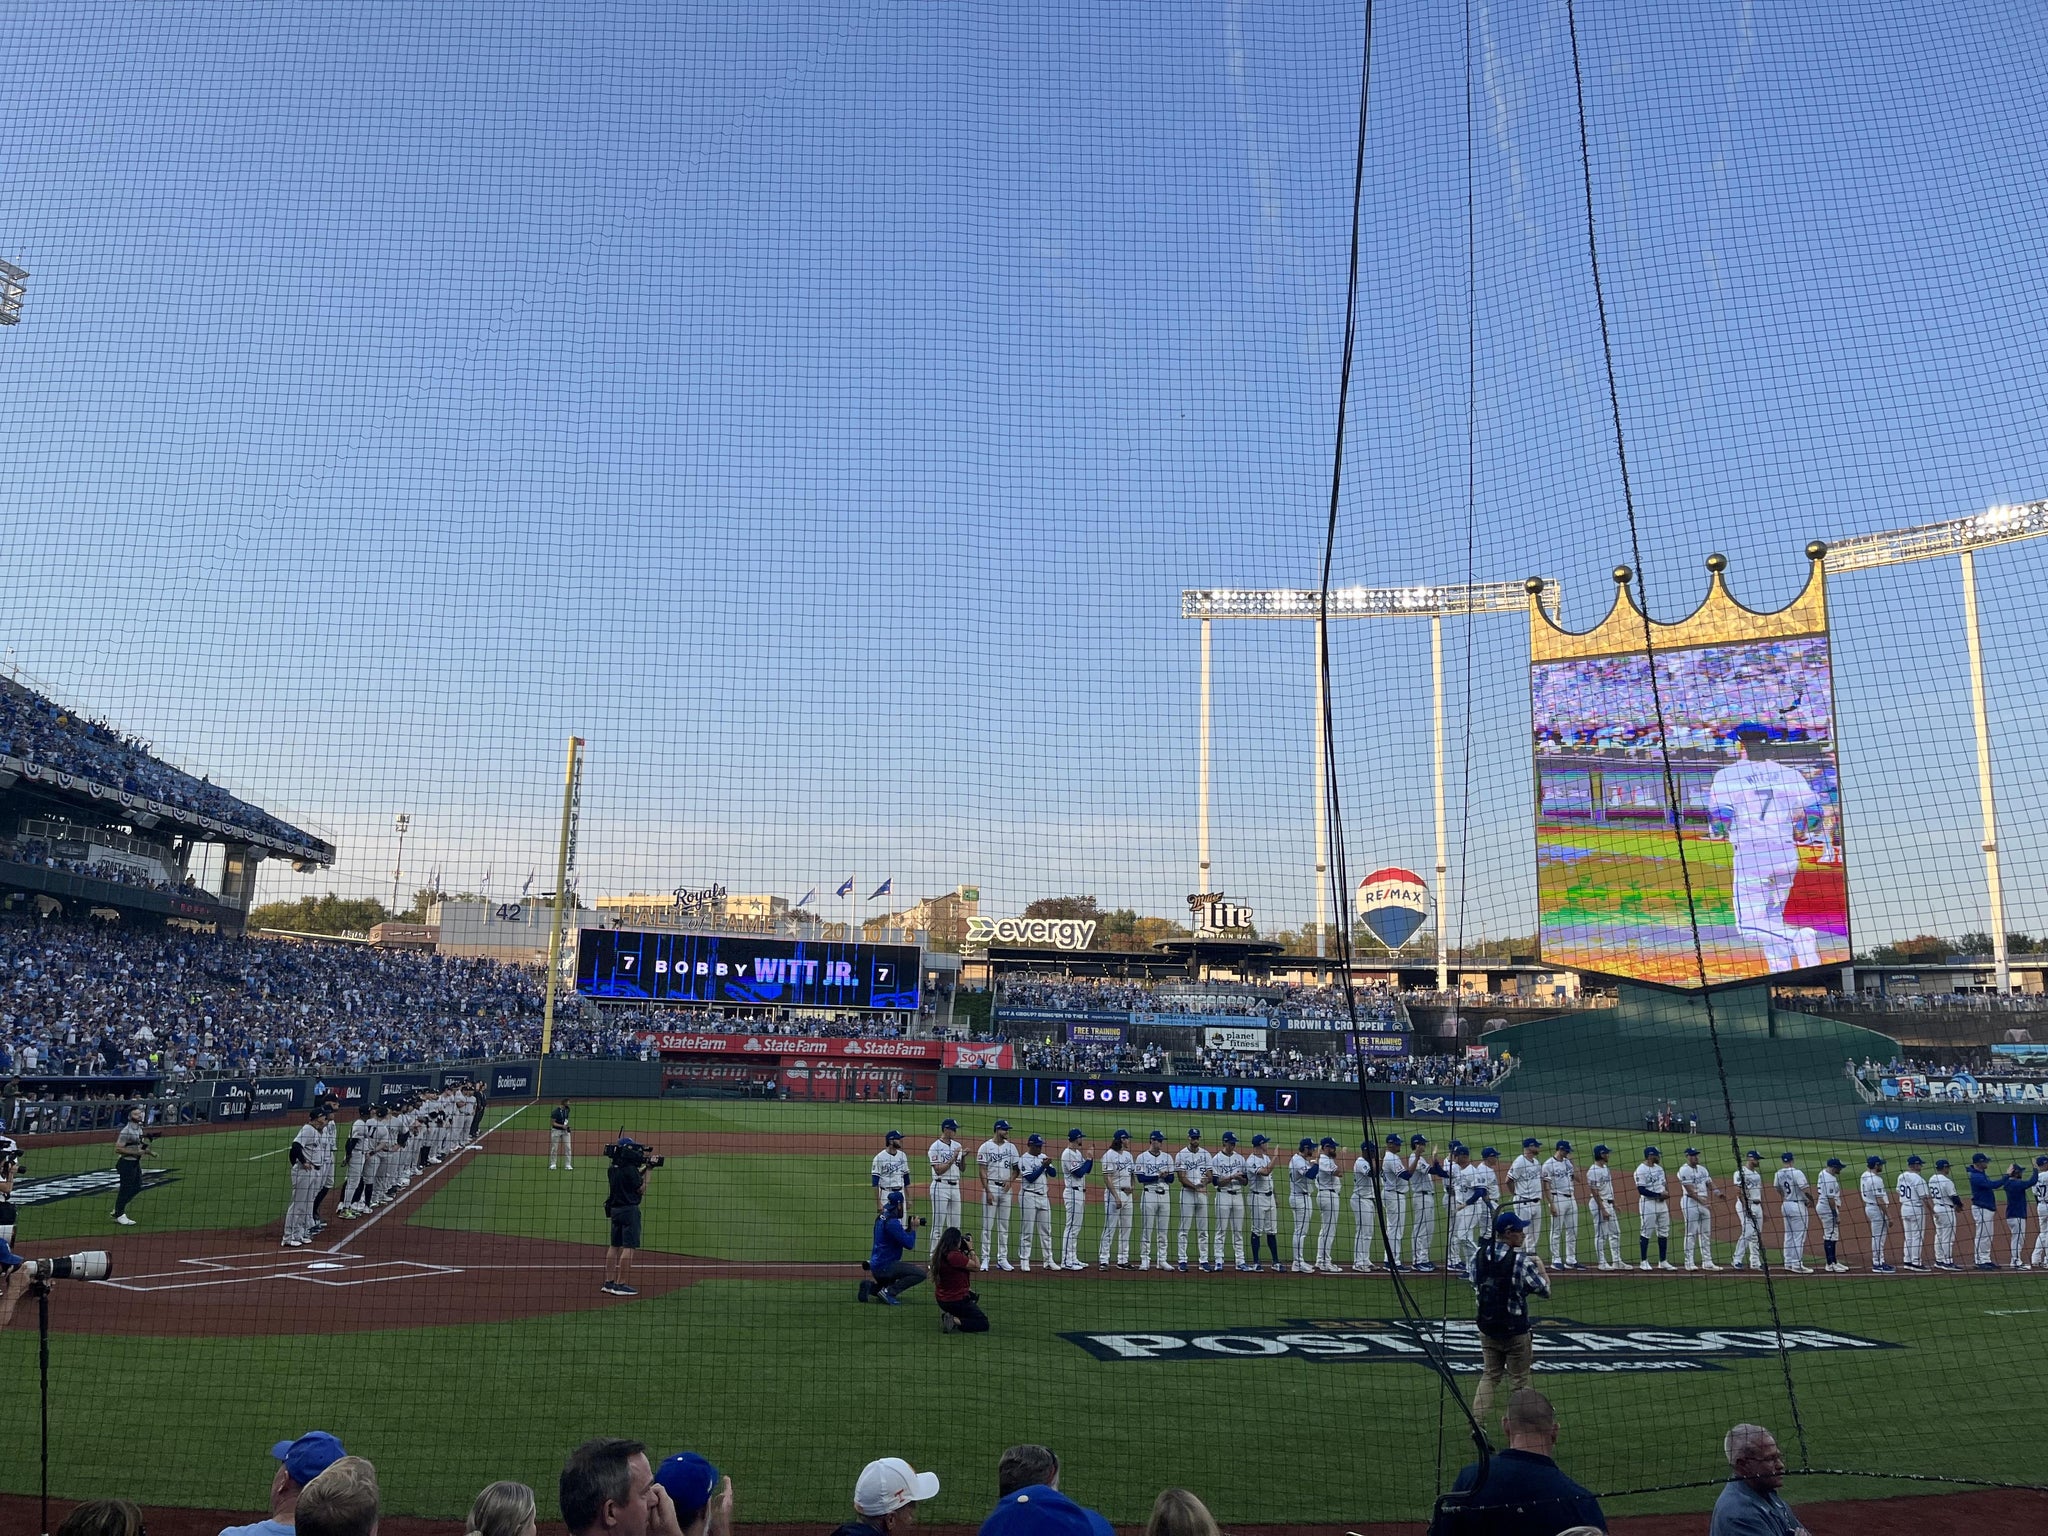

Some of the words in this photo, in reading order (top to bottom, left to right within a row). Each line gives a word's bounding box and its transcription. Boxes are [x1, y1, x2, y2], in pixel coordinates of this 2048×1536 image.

[1755, 788, 1773, 821] 7
[672, 882, 728, 910] Royals
[1366, 888, 1421, 904] RE/MAX
[496, 903, 520, 921] 42
[619, 905, 684, 929] HALL
[688, 912, 710, 932] of
[711, 911, 778, 934] FAME
[1200, 902, 1253, 934] Lite
[821, 922, 846, 941] 20
[863, 923, 881, 942] 10
[904, 926, 917, 944] 5
[998, 919, 1096, 949] evergy
[623, 956, 635, 970] 7
[655, 960, 747, 977] BOBBY
[754, 957, 818, 984] WITT
[823, 961, 859, 986] JR.
[878, 968, 889, 981] 7
[1073, 1026, 1089, 1034] FREE
[1091, 1027, 1121, 1036] TRAINING
[1287, 1019, 1321, 1030] BROWN
[1324, 1019, 1332, 1030] &
[1226, 1031, 1255, 1041] planet
[1371, 1037, 1402, 1046] TRAINING
[1230, 1040, 1260, 1048] fitness
[960, 1053, 996, 1063] SONIC
[498, 1075, 527, 1090] Booking.com
[1057, 1086, 1066, 1099] 7
[1083, 1089, 1164, 1103] BOBBY
[1169, 1085, 1227, 1110] WITT
[1231, 1087, 1265, 1111] JR.
[1282, 1094, 1292, 1107] 7
[1904, 1120, 1942, 1132] Kansas
[1944, 1122, 1966, 1133] City
[1783, 1181, 1792, 1195] 9
[1900, 1184, 1912, 1200] 90
